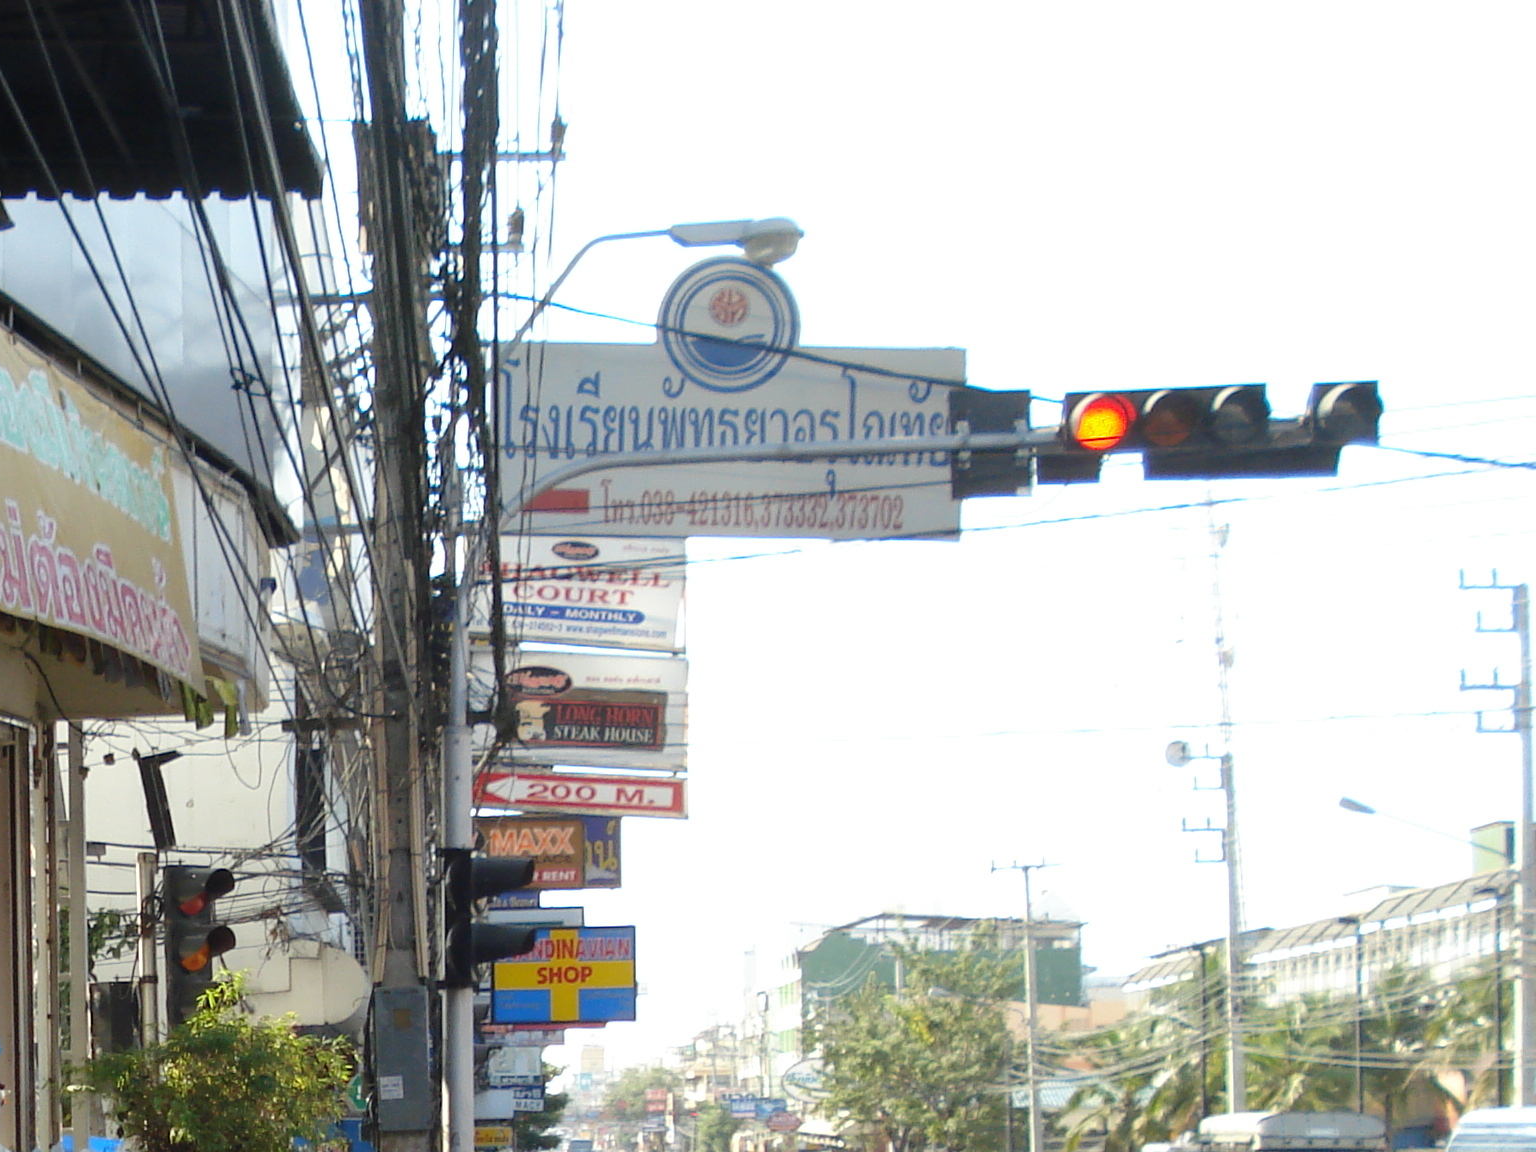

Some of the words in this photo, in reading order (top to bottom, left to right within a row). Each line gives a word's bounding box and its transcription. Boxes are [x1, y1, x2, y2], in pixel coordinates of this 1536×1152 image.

[512, 582, 635, 608] COURT
[503, 603, 546, 617] DAILY
[565, 606, 637, 622] MONTHLY
[555, 703, 603, 727] LONG
[605, 705, 655, 728] HORN
[553, 723, 600, 740] STEAK
[603, 725, 655, 744] HOUSE
[527, 782, 598, 804] 200
[615, 786, 656, 806] M.
[489, 826, 576, 857] MAXX
[541, 868, 577, 882] RENT
[536, 965, 594, 985] SHOP
